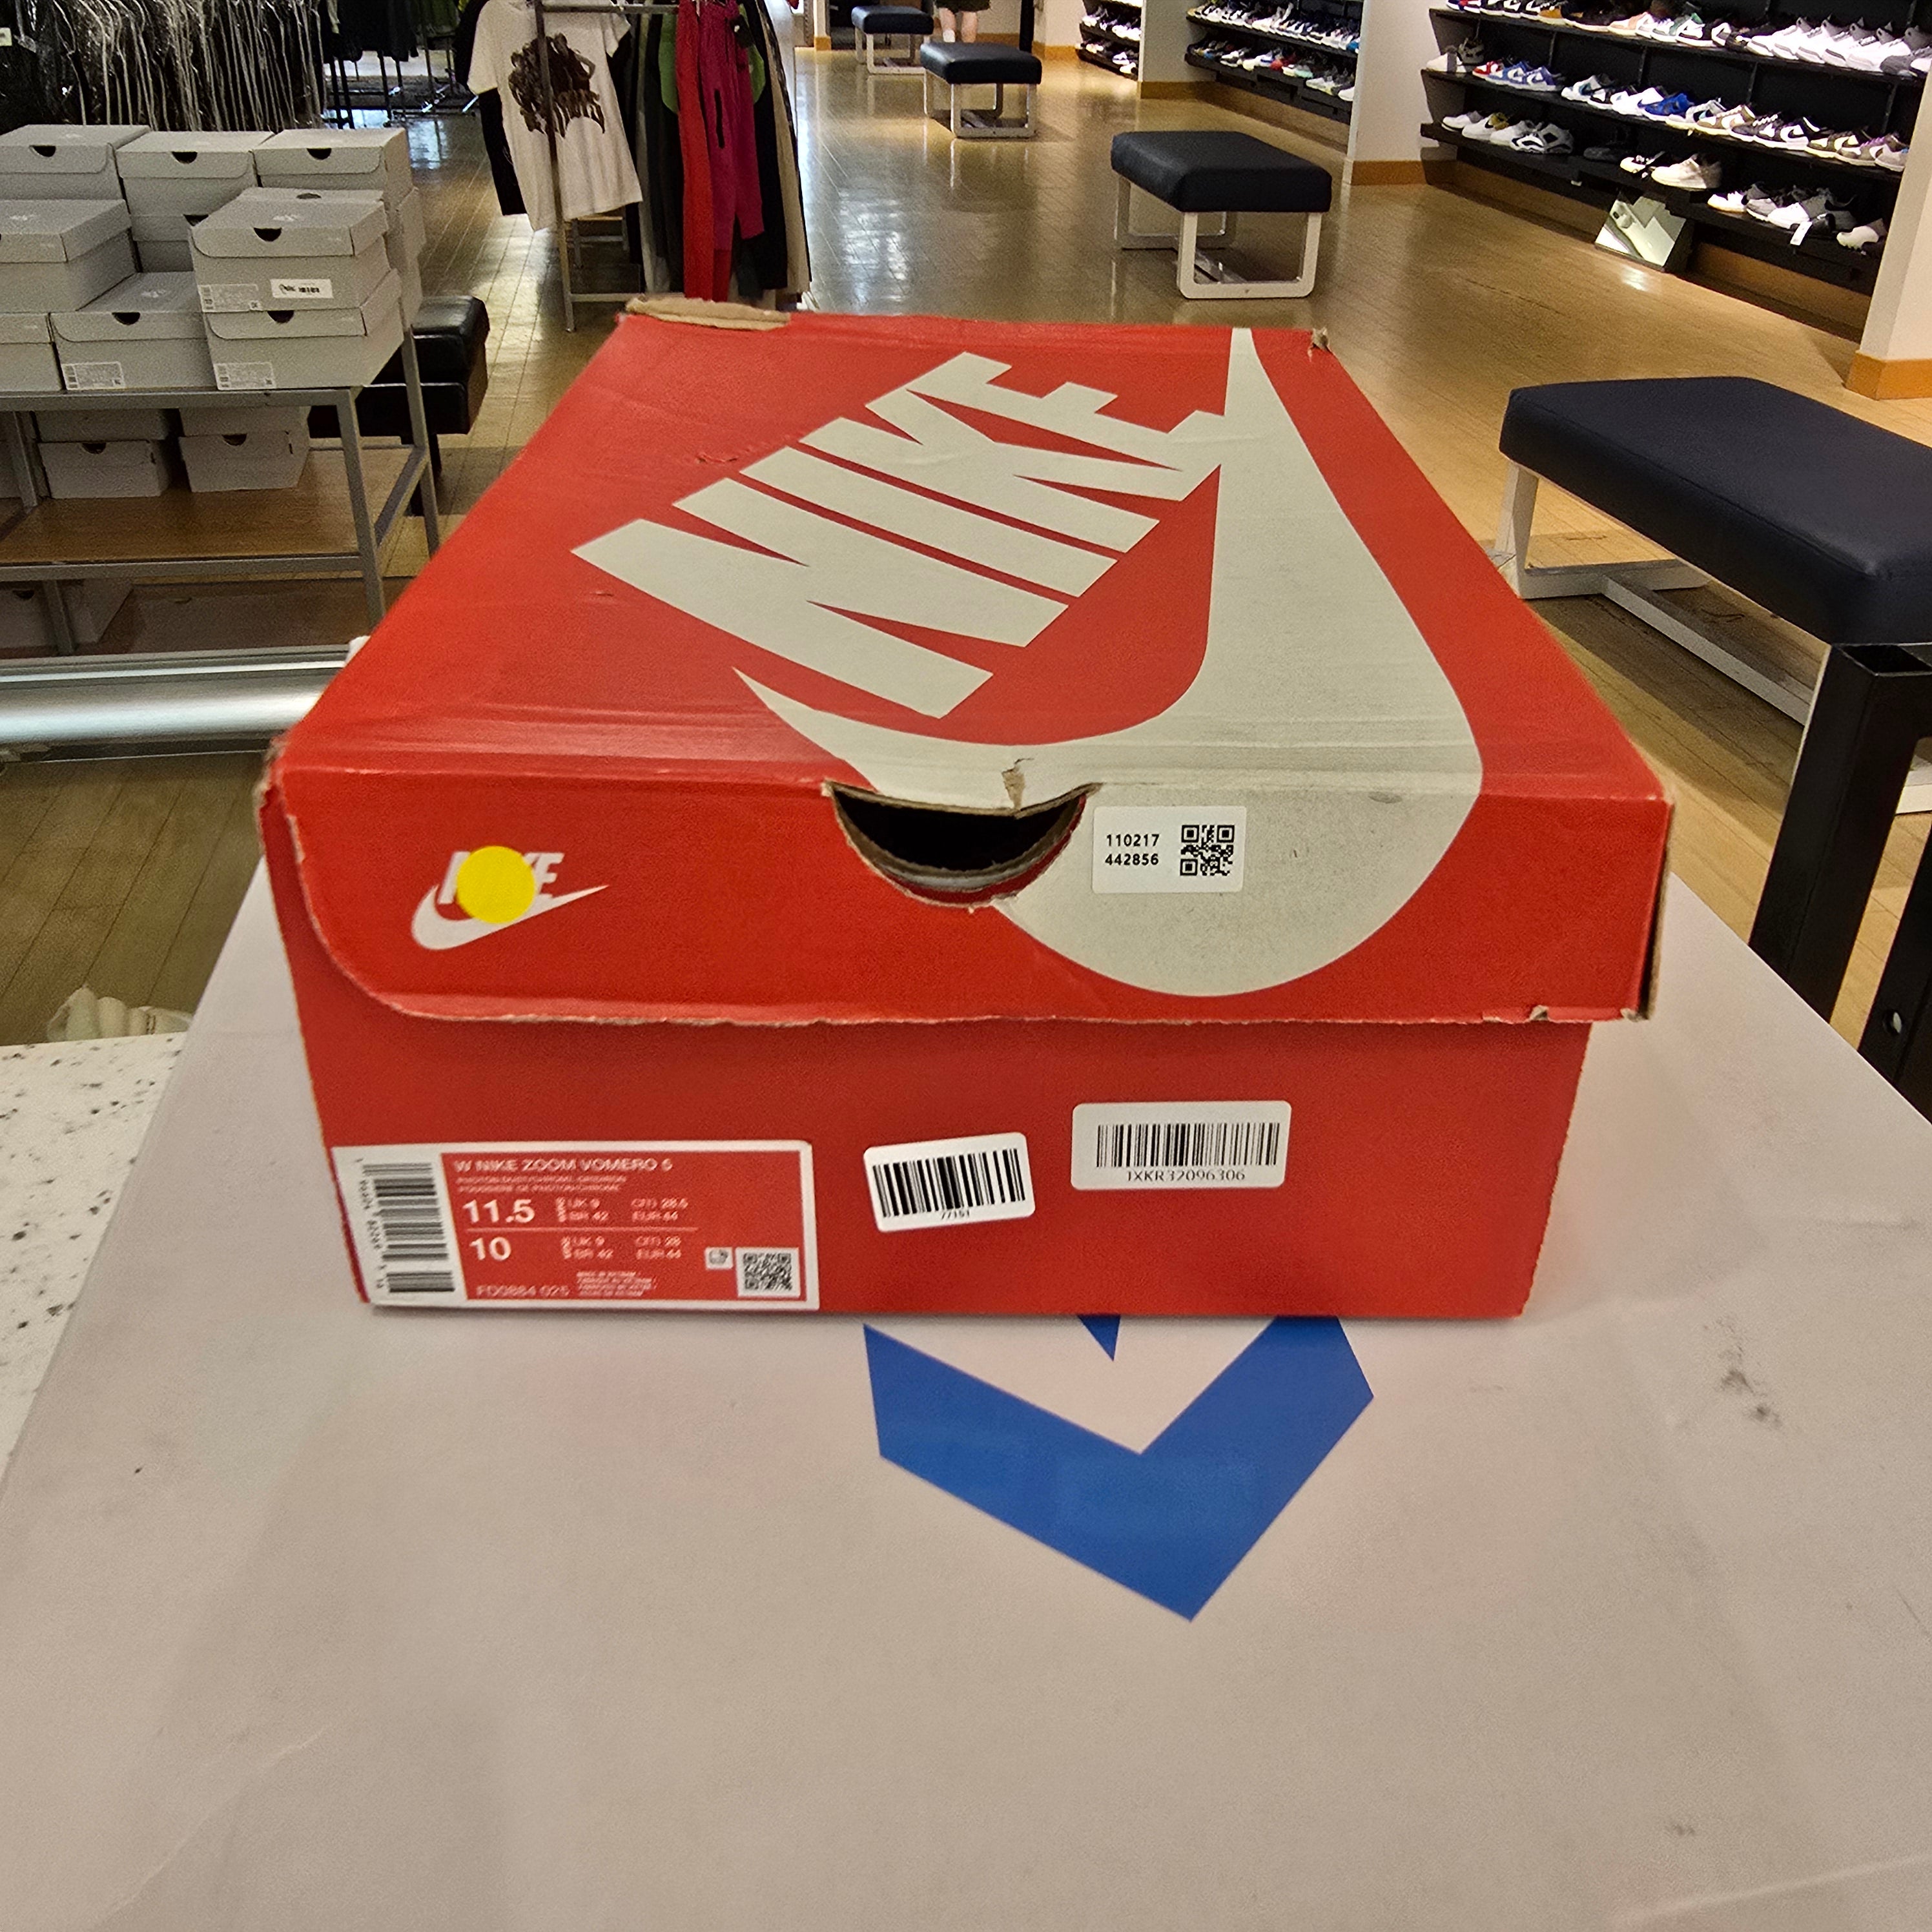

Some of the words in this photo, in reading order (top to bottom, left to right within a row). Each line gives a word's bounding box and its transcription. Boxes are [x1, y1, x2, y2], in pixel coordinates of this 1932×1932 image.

[571, 352, 1225, 718] NIKE
[1107, 834, 1160, 847] 110217
[1105, 854, 1159, 865] 442856
[475, 1159, 517, 1172] NIKE
[522, 1158, 577, 1171] ZOOM
[581, 1158, 658, 1172] VOMERO
[463, 1198, 536, 1223] 11.5
[469, 1237, 512, 1260] 10
